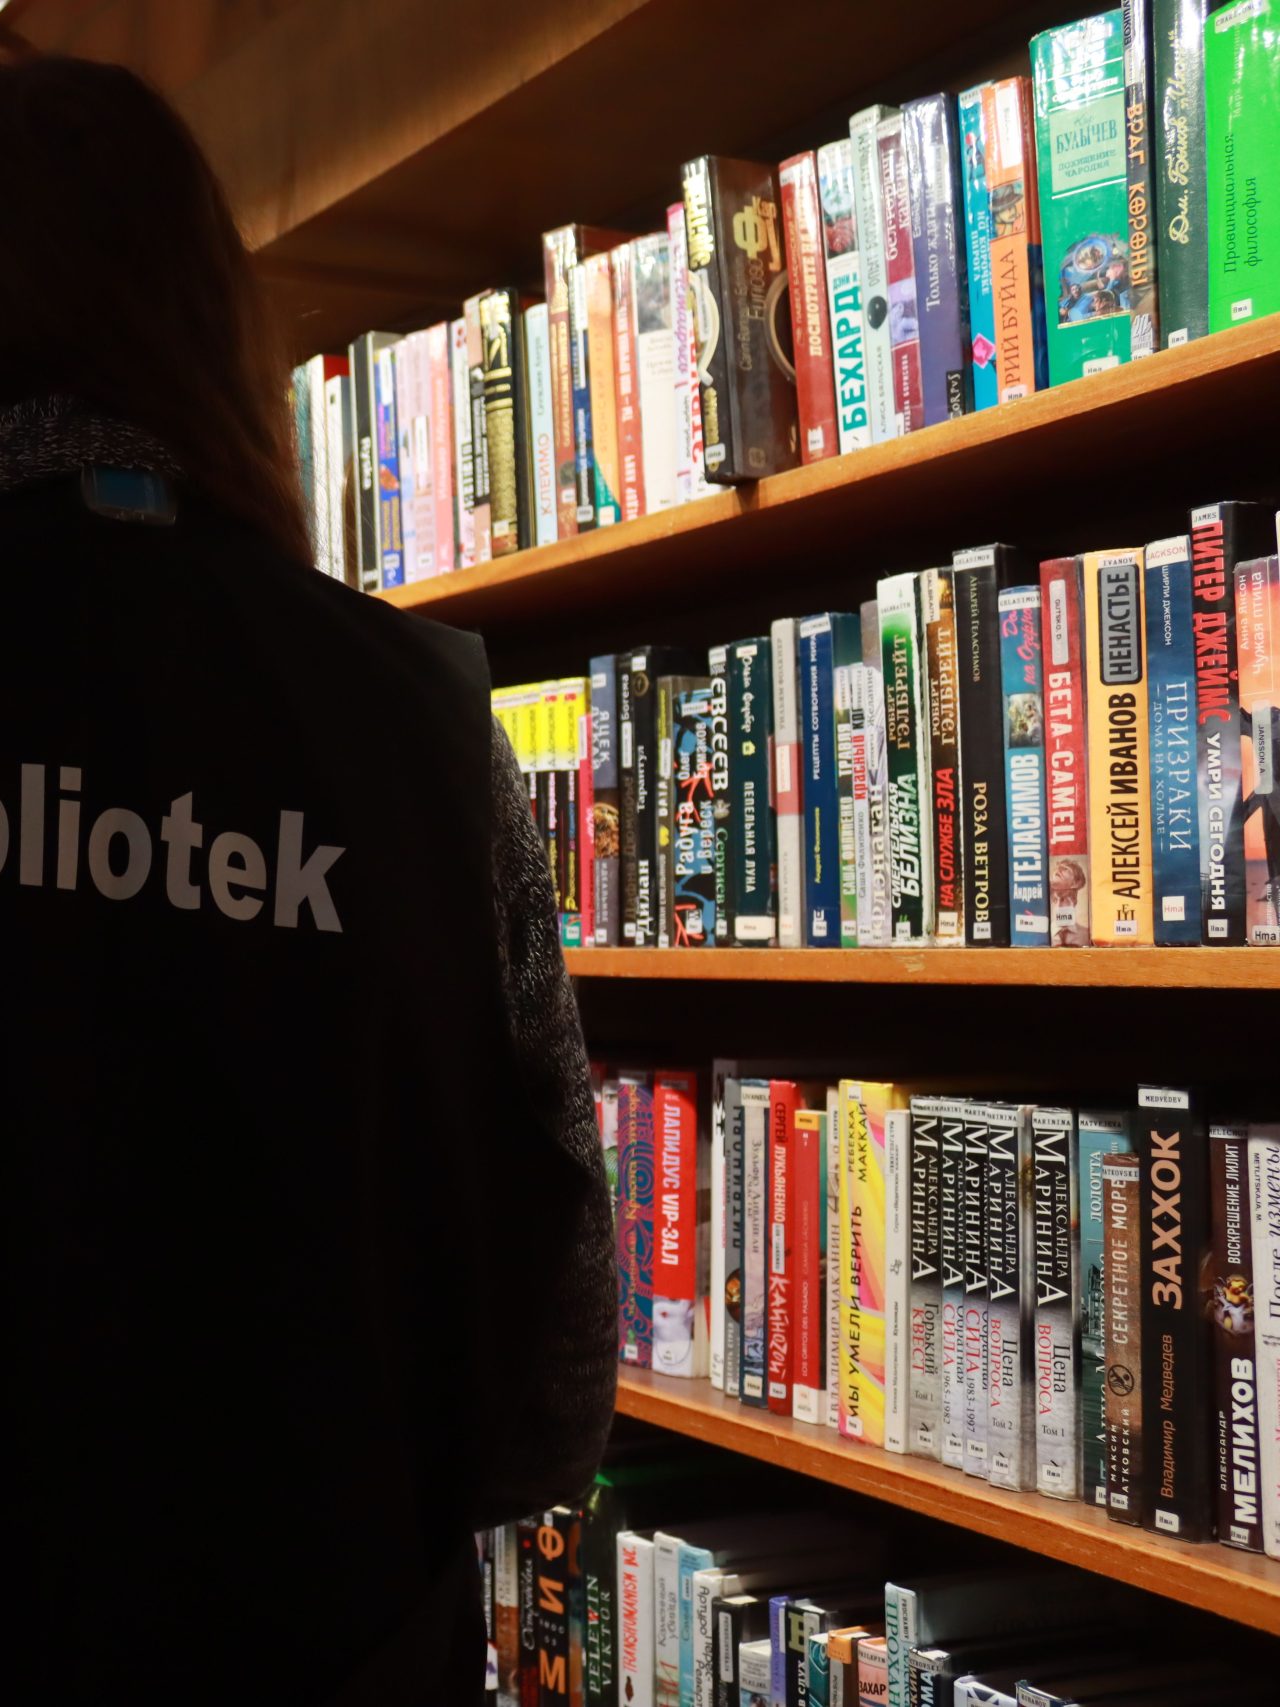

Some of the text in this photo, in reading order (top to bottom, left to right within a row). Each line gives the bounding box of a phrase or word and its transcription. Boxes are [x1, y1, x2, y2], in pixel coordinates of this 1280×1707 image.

[1056, 119, 1117, 154] БУЛЫЧЕВ
[1126, 104, 1145, 165] ВРАГ
[1128, 183, 1149, 287] КОРОНЫ
[1169, 190, 1190, 244] Дм.
[1222, 133, 1238, 274] Провинциальная
[1242, 176, 1260, 268] философия
[802, 256, 824, 357] ПОСМОТРИТЕ
[926, 254, 942, 312] Только
[999, 249, 1020, 328] БУЙДА
[833, 286, 868, 432] БЕХАРД
[360, 437, 373, 491] Ryska
[1103, 557, 1135, 567] IVANOV
[1146, 545, 1187, 561] JACKSON
[1193, 511, 1217, 523] JAMES
[1107, 572, 1132, 675] НЕНАСТЬЕ
[1161, 564, 1173, 646] ШИРЛИ ДЖЕКСОН
[1192, 521, 1238, 725] ПИТЕР ДЖЕЙМС
[1236, 573, 1251, 651] Анна Янсон
[1249, 571, 1267, 674] Чужая птица
[620, 673, 631, 721] Богема
[809, 634, 820, 780] РЕЦЕПТЫ СОТВОРЕНИЯ МИРА
[886, 684, 897, 742] РОБЕРТ
[891, 634, 912, 751] ГЭЛБРЕЙТ
[930, 678, 941, 737] РОБЕРТ
[936, 627, 956, 746] ГЭЛБРЕЙТ
[1153, 700, 1164, 748] ДОМА
[599, 710, 611, 763] ЯЦЕК
[635, 744, 648, 813] Тарантул
[677, 750, 691, 781] Олег
[692, 722, 709, 780] Ермаков
[710, 677, 729, 791] ЕВСЕЕВ
[837, 723, 853, 778] ТРАВЛЯ
[1048, 671, 1078, 846] БЕТА-САМЕЦ
[1165, 681, 1191, 852] ПРИЗРАКИ
[674, 800, 699, 876] Радуга
[696, 799, 714, 860] Вереск
[743, 781, 756, 893] ПЕПЕЛЬНАЯ ЛУНА
[897, 772, 920, 898] БЕЛИЗНА
[936, 767, 955, 908] НА СЛУЖБЕ ЗЛА
[1010, 754, 1042, 882] ГЕЛАСИМОВ
[1106, 692, 1141, 900] АЛЕКСЕЙ ИВАНОВ
[1153, 779, 1166, 835] ХОЛМЕ
[1205, 733, 1225, 911] УМРИ СЕГОДНЯ
[714, 827, 729, 903] Сергиев
[888, 782, 903, 909] СМЕРТЕЛЬНАЯ
[972, 781, 989, 922] РОЗА ВЕТРОВ
[635, 859, 655, 935] Дилан
[1014, 884, 1044, 899] Андрей
[773, 1102, 787, 1144] СЕРГЕЙ
[847, 1109, 856, 1173] РЕБЕККА
[852, 1102, 868, 1183] МАККАЙ
[1145, 1095, 1182, 1104] MEDVEDEV
[660, 1103, 681, 1265] ЛАПИДУС VIP-ЗАЛ
[772, 1144, 787, 1223] ЛУКЬЯНЕНКО
[911, 1117, 939, 1281] МАРИНИНА
[927, 1154, 938, 1256] АЛЕКСАНДРА
[941, 1121, 963, 1289] МАРИНИНА
[965, 1121, 988, 1294] МАРИНИНА
[987, 1128, 1016, 1302] МАРИНИНА
[1004, 1168, 1017, 1275] АЛЕКСАНДРА
[1033, 1129, 1067, 1308] МАРИНИНА
[1054, 1170, 1068, 1278] АЛЕКСАНДРА
[1089, 1151, 1103, 1223] ЛОЛОТТА
[1149, 1129, 1182, 1310] ЗАХХОК
[1223, 1143, 1243, 1266] ВОСКРЕШЕНИЕ ЛИЛИТ
[849, 1205, 863, 1287] ВЕРИТЬ
[1110, 1237, 1129, 1345] СЕКРЕТНОЕ
[827, 1225, 840, 1413] ВЛАДИМИР МАКАНИН
[847, 1293, 862, 1375] УМЕЛИ
[911, 1307, 925, 1376] КВЕСТ
[920, 1303, 939, 1375] Горький
[942, 1303, 958, 1424] СИЛА 1965-1982
[989, 1318, 1003, 1408] ВОПРОСА
[1000, 1338, 1019, 1387] Цена
[966, 1308, 984, 1433] СИЛА 1983-1997
[1037, 1323, 1053, 1416] ВОПРОСА
[1051, 1344, 1070, 1394] Цена
[1109, 1423, 1118, 1483] МАКСИМ
[1159, 1334, 1176, 1499] Владимир Медведев
[1218, 1410, 1228, 1492] АЛЕКСАНДР
[1230, 1356, 1257, 1525] МЕЛИХОВ
[600, 1589, 612, 1686] VIKTOR
[622, 1572, 638, 1674] TRANSHUMANISM
[697, 1585, 711, 1636] Артуро
[858, 1681, 887, 1697] ЗАХАР
